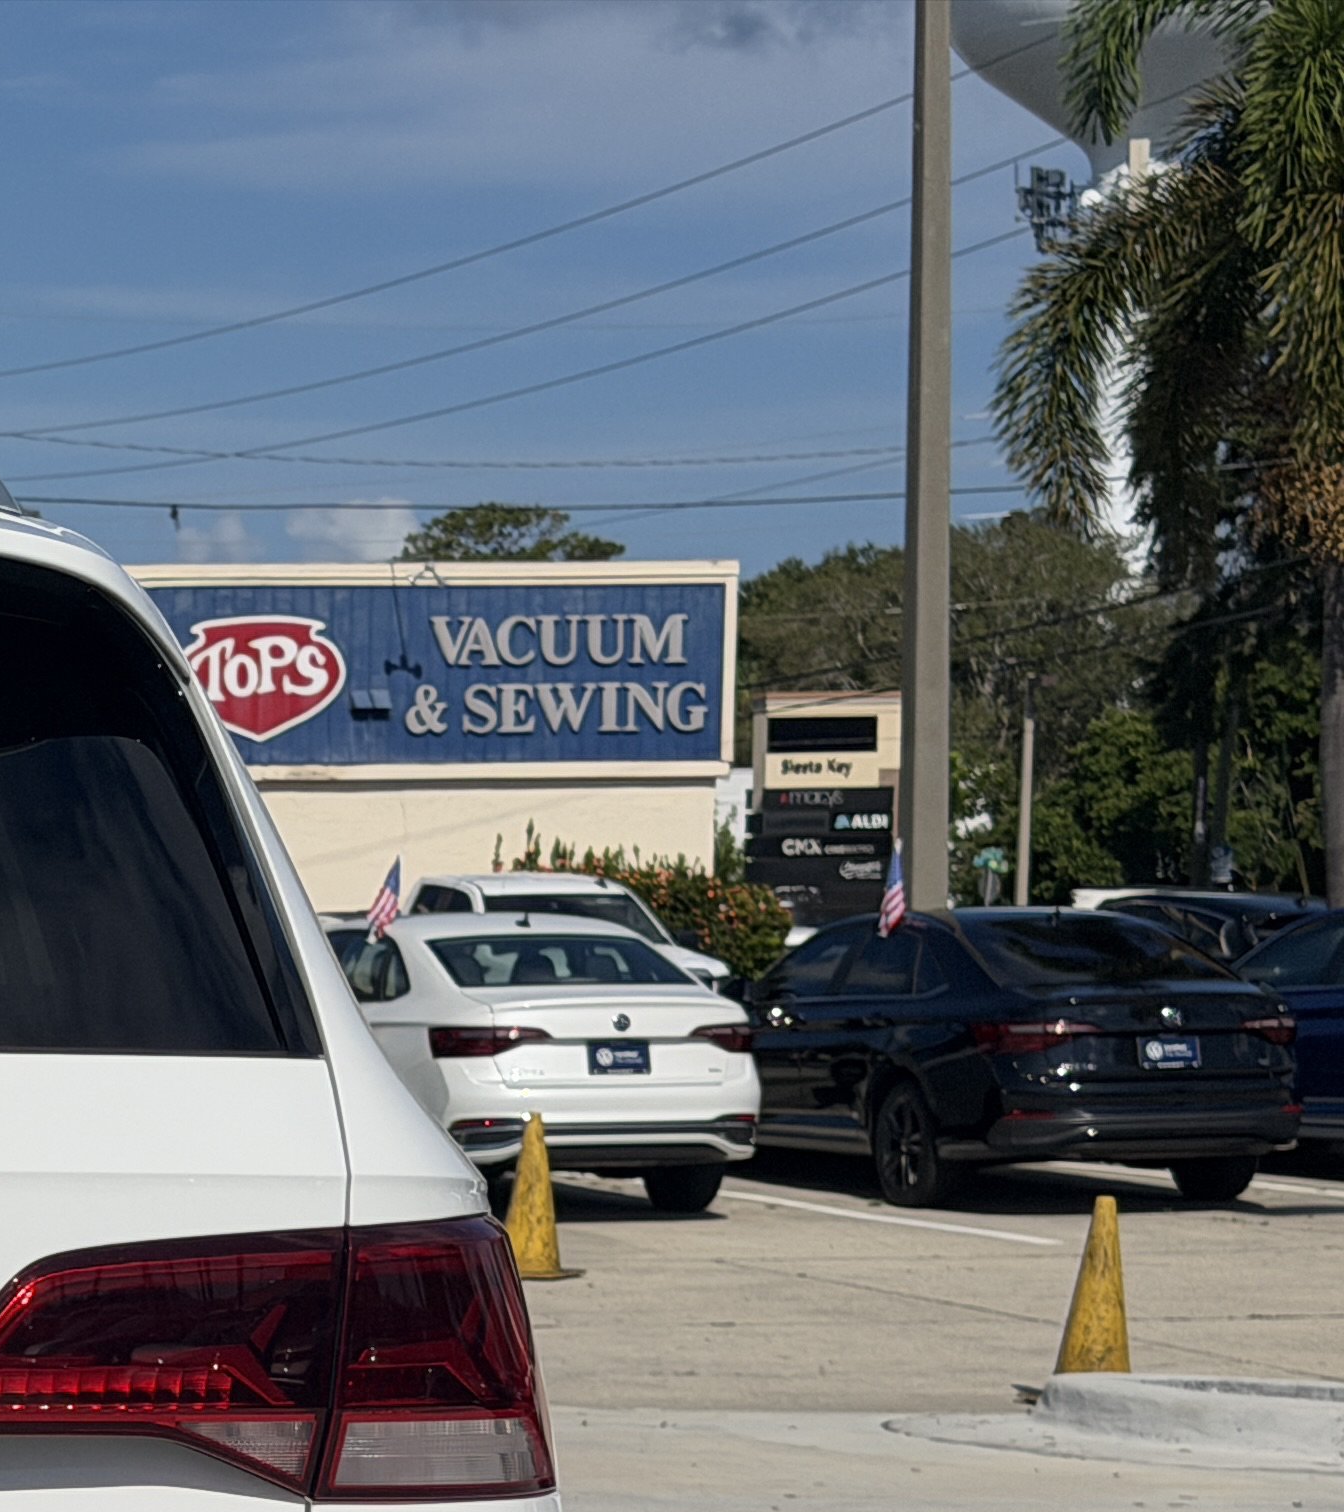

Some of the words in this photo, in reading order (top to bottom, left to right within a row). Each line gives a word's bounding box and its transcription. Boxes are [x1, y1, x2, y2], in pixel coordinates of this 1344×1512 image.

[429, 613, 689, 666] VACUUM
[404, 684, 449, 735] &
[462, 681, 709, 735] SEWING
[781, 759, 822, 775] Siesta
[827, 758, 853, 779] Key
[851, 813, 889, 830] ALDI
